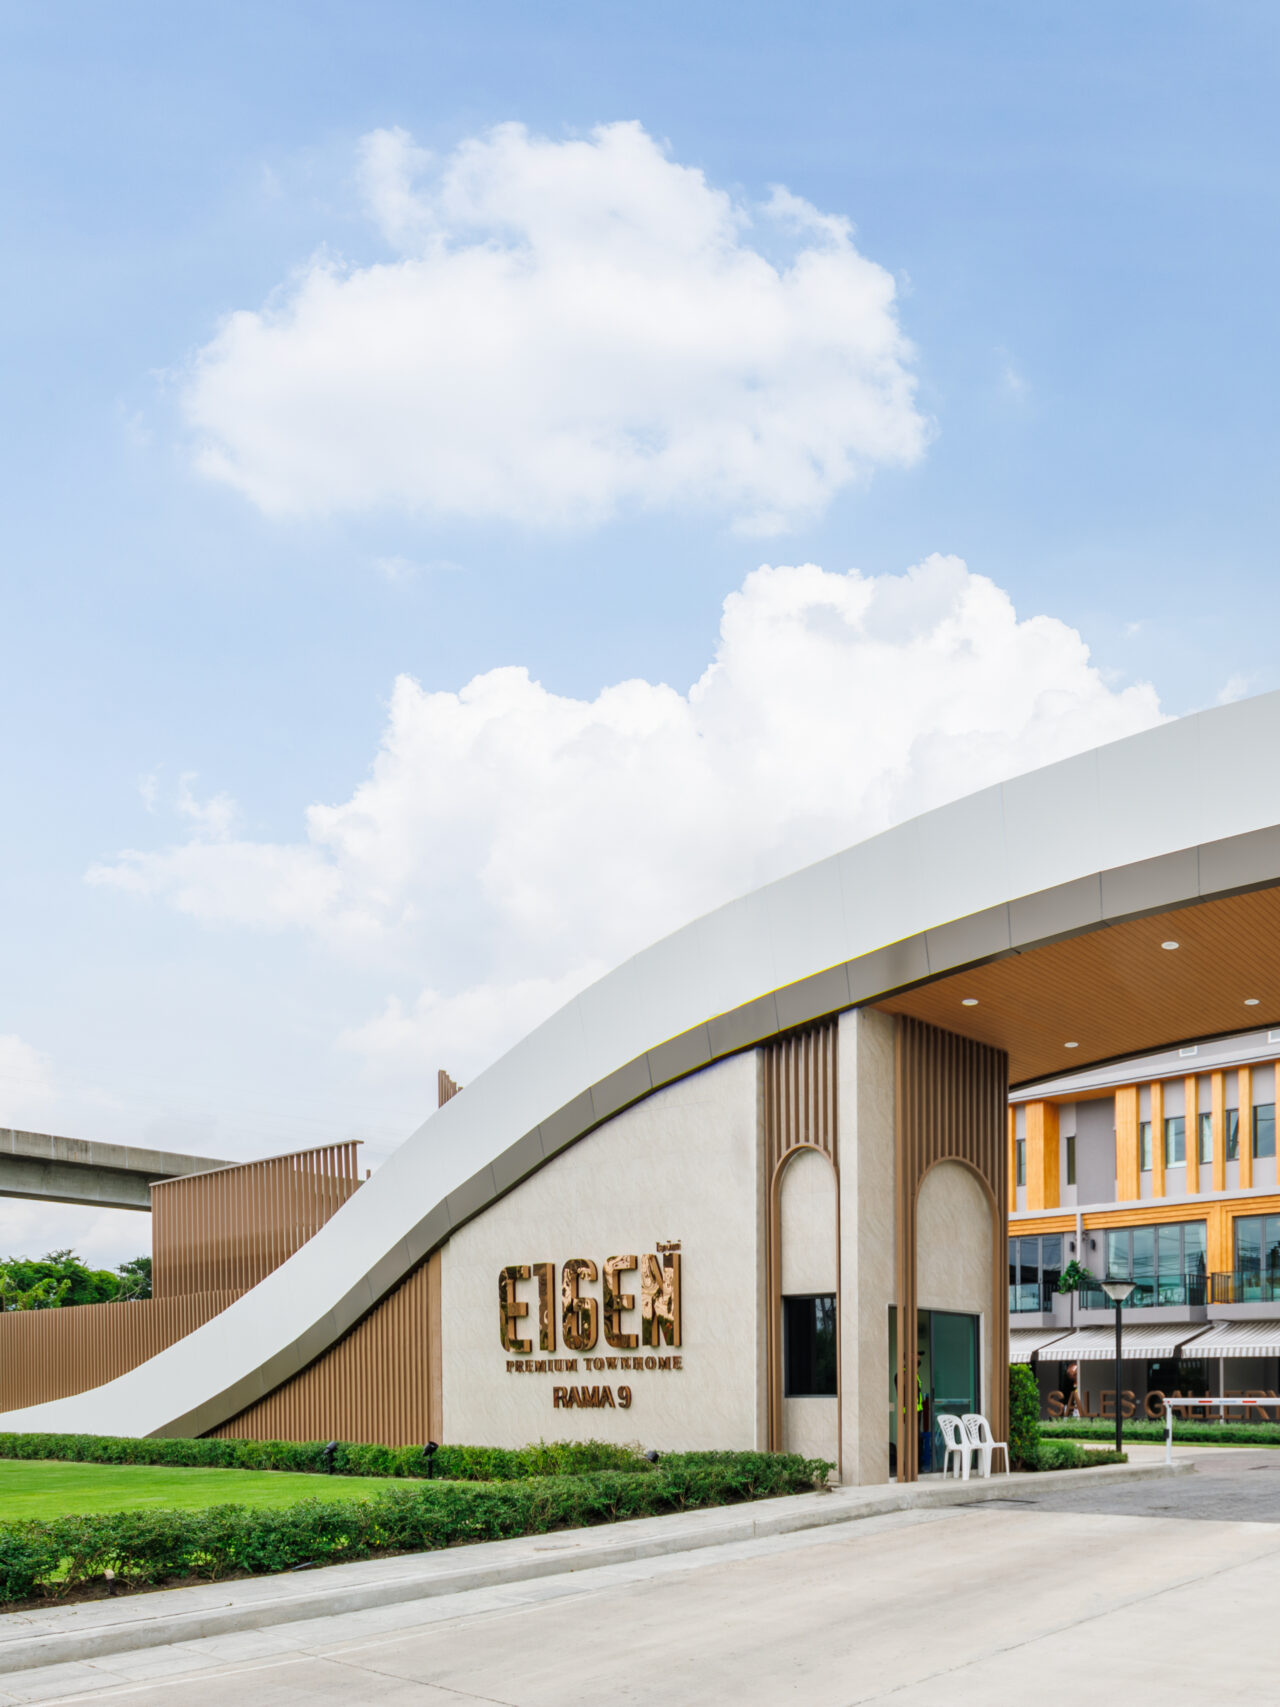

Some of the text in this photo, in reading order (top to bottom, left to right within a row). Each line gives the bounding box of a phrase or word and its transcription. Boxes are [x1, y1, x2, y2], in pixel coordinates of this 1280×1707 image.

[506, 1356, 682, 1373] PREMIUM TOWNHOME
[553, 1385, 632, 1408] RAMA 9
[1048, 1390, 1135, 1418] SALES
